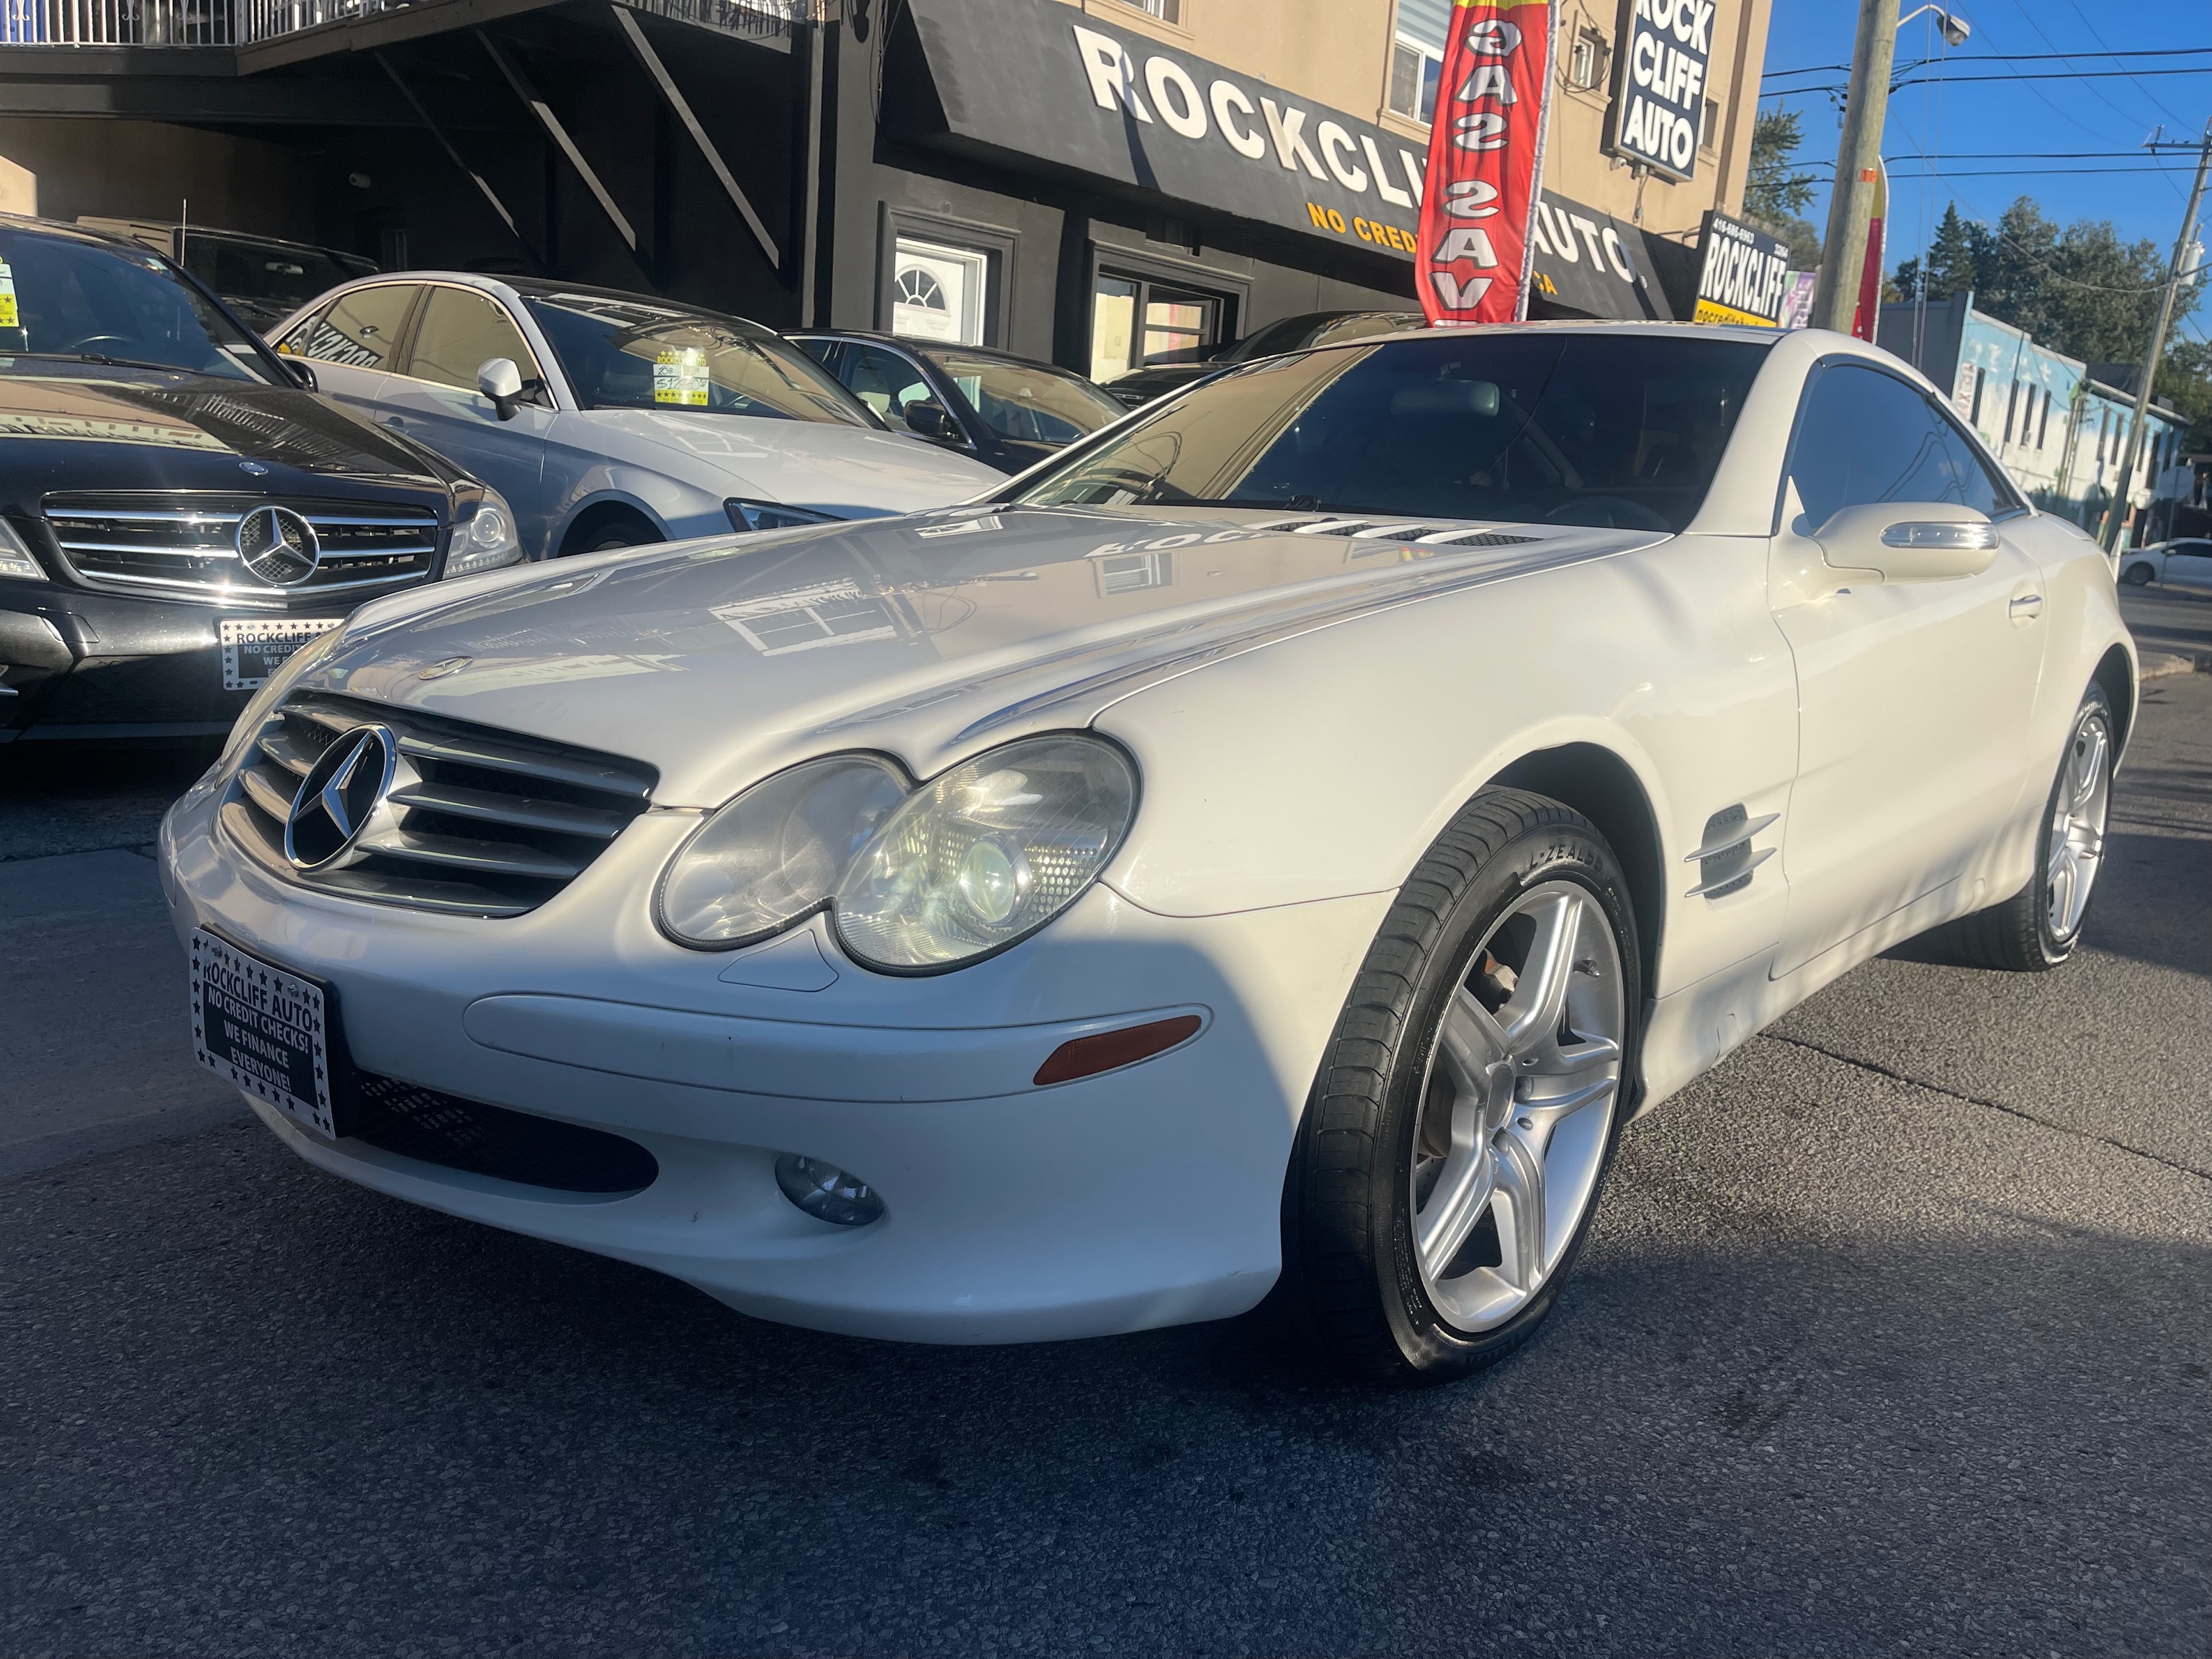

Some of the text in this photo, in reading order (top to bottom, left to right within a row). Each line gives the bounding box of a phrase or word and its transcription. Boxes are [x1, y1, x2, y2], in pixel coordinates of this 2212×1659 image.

[1632, 31, 1704, 110] CLIFF
[1073, 24, 1428, 208] ROCKCLI
[1623, 94, 1694, 169] AUTO
[1306, 202, 1346, 234] NO
[1699, 232, 1788, 319] ROCKCLIFF
[237, 632, 311, 644] ROCKCLIFF
[243, 645, 261, 654] NO
[263, 656, 280, 665] WE
[202, 961, 313, 1033] ROCKCLIFF AUTO
[208, 987, 309, 1054] NO CREDIT CHECKS!
[223, 1019, 289, 1069] WE FINANCE
[230, 1046, 292, 1093] EVERYONE!
